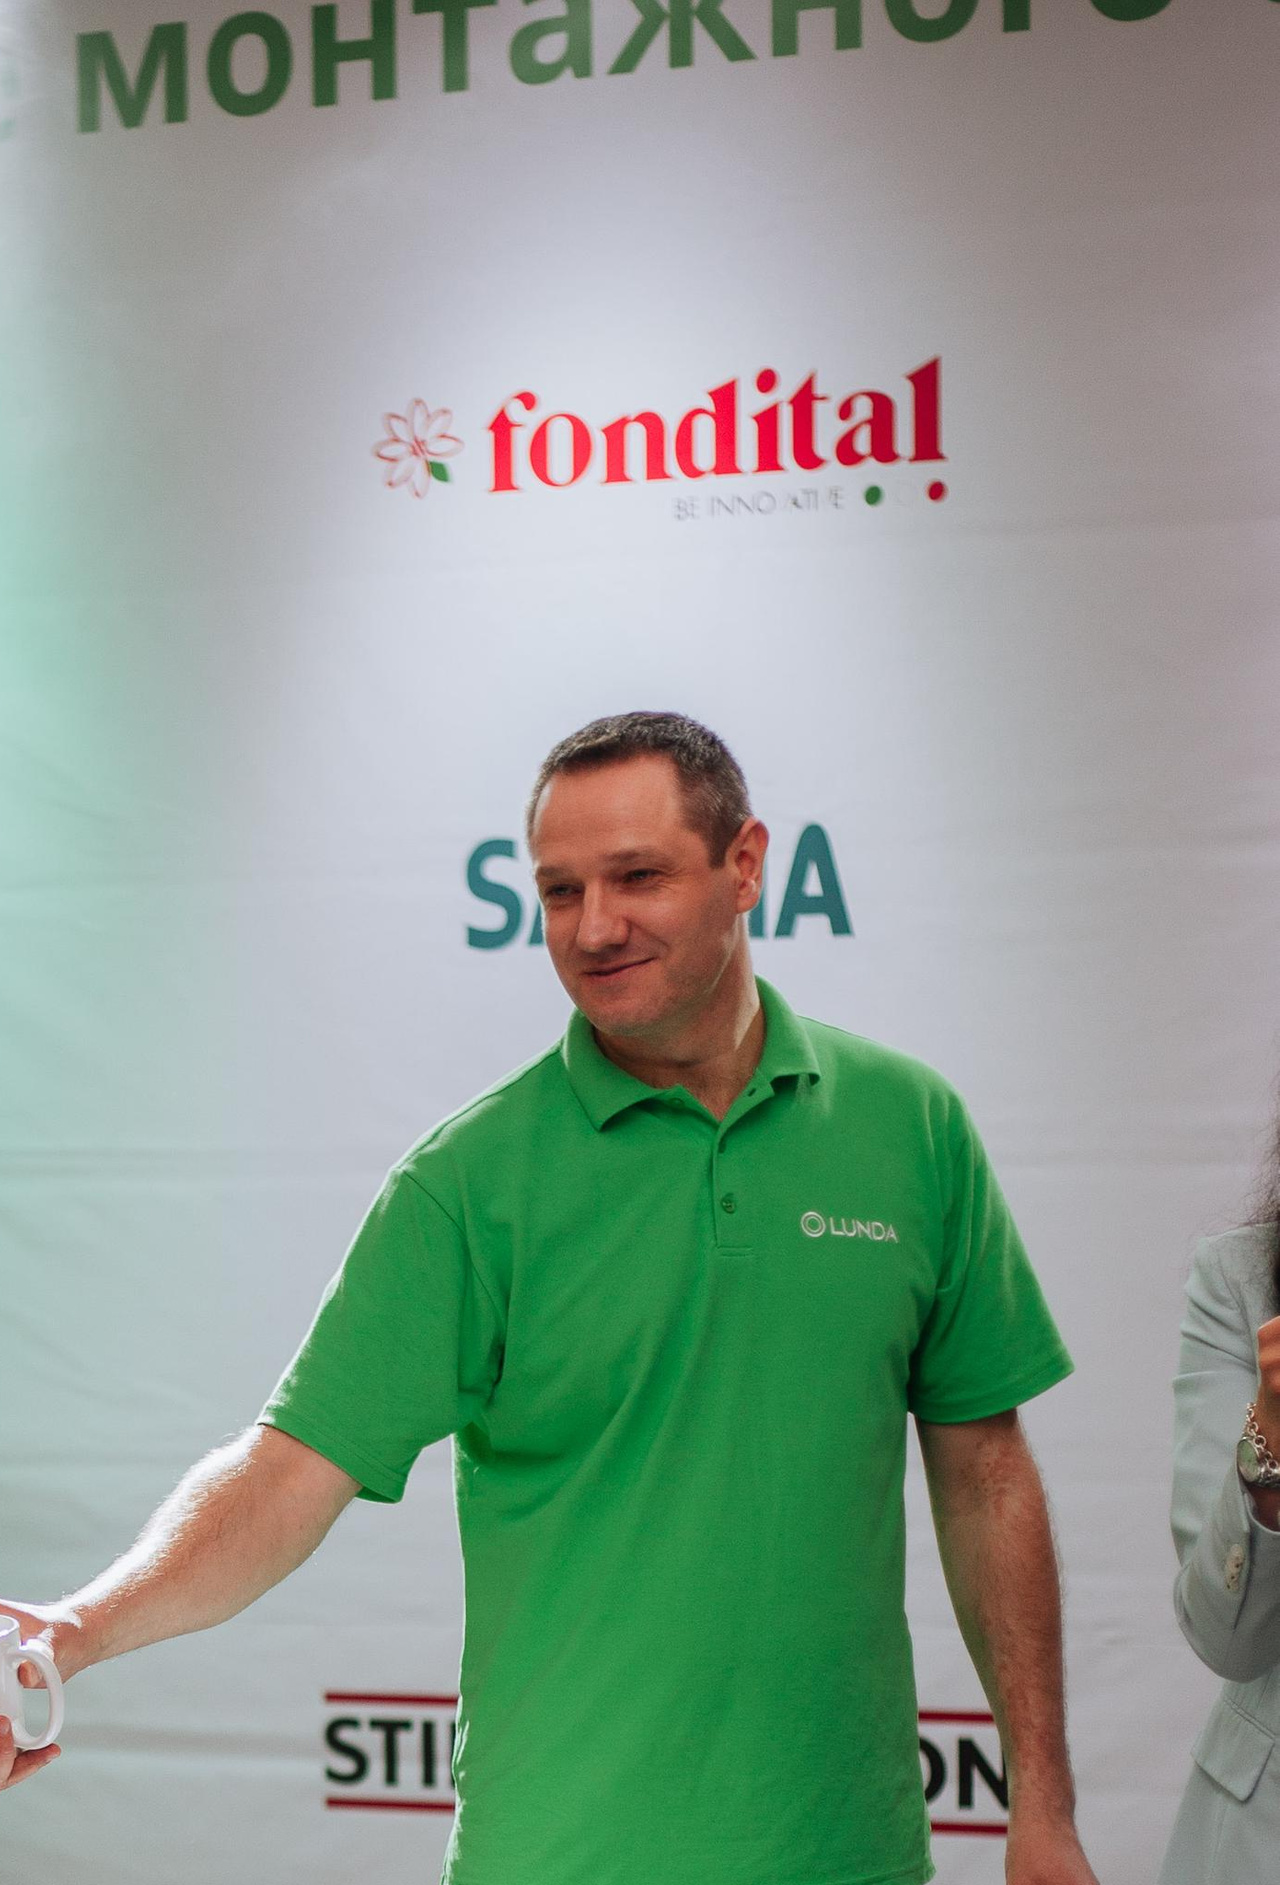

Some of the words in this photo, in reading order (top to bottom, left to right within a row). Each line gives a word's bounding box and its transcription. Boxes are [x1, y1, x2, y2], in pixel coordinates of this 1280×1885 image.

[76, 0, 1170, 133] монтажн
[485, 355, 949, 492] fondital
[711, 485, 845, 517] INNOATIE
[325, 1716, 456, 1788] STI
